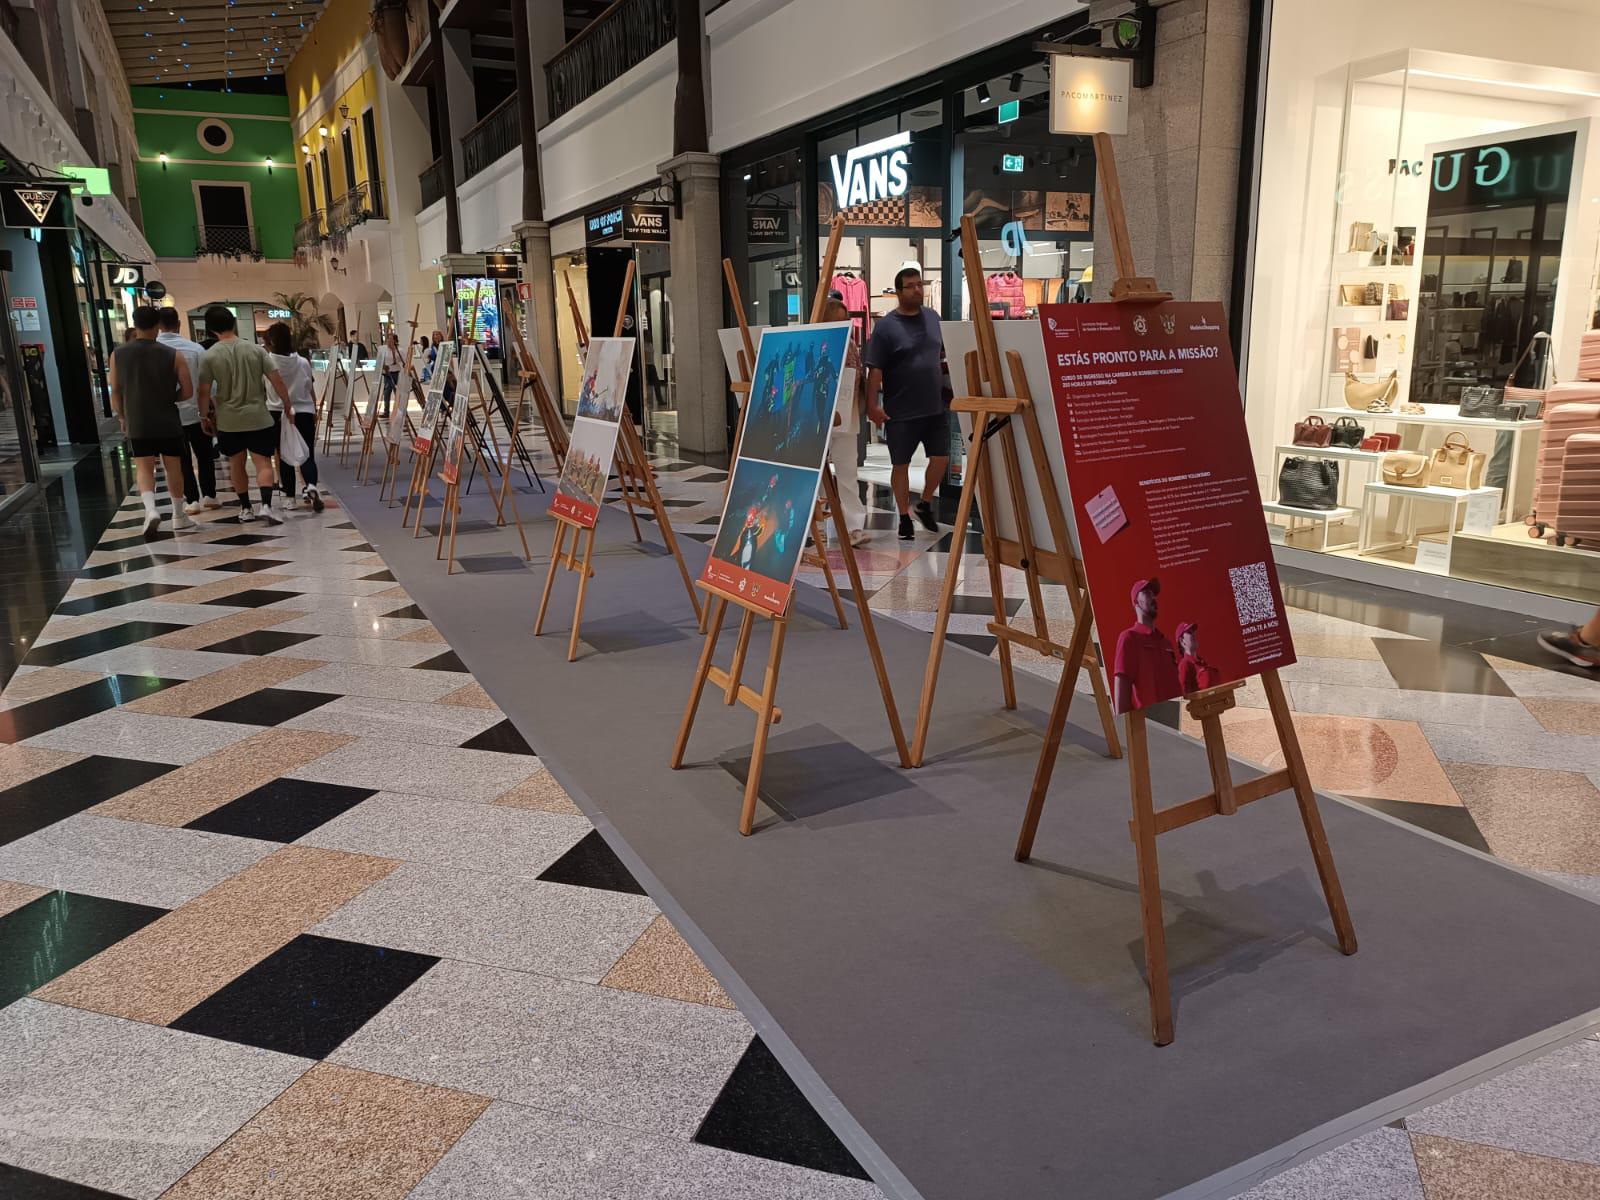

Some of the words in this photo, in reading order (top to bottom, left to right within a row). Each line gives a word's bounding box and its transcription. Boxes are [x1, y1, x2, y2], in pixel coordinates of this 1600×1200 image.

[1060, 90, 1123, 103] PACOMARTINEZ
[829, 130, 911, 208] VANS
[21, 191, 51, 201] GUESS
[631, 213, 663, 227] VANS
[113, 267, 140, 285] JD
[1057, 350, 1090, 366] ESTÁS
[1092, 350, 1138, 364] PRONTO
[1139, 349, 1166, 361] PARA
[1169, 348, 1176, 360] A
[1177, 344, 1218, 359] MISSÃO?
